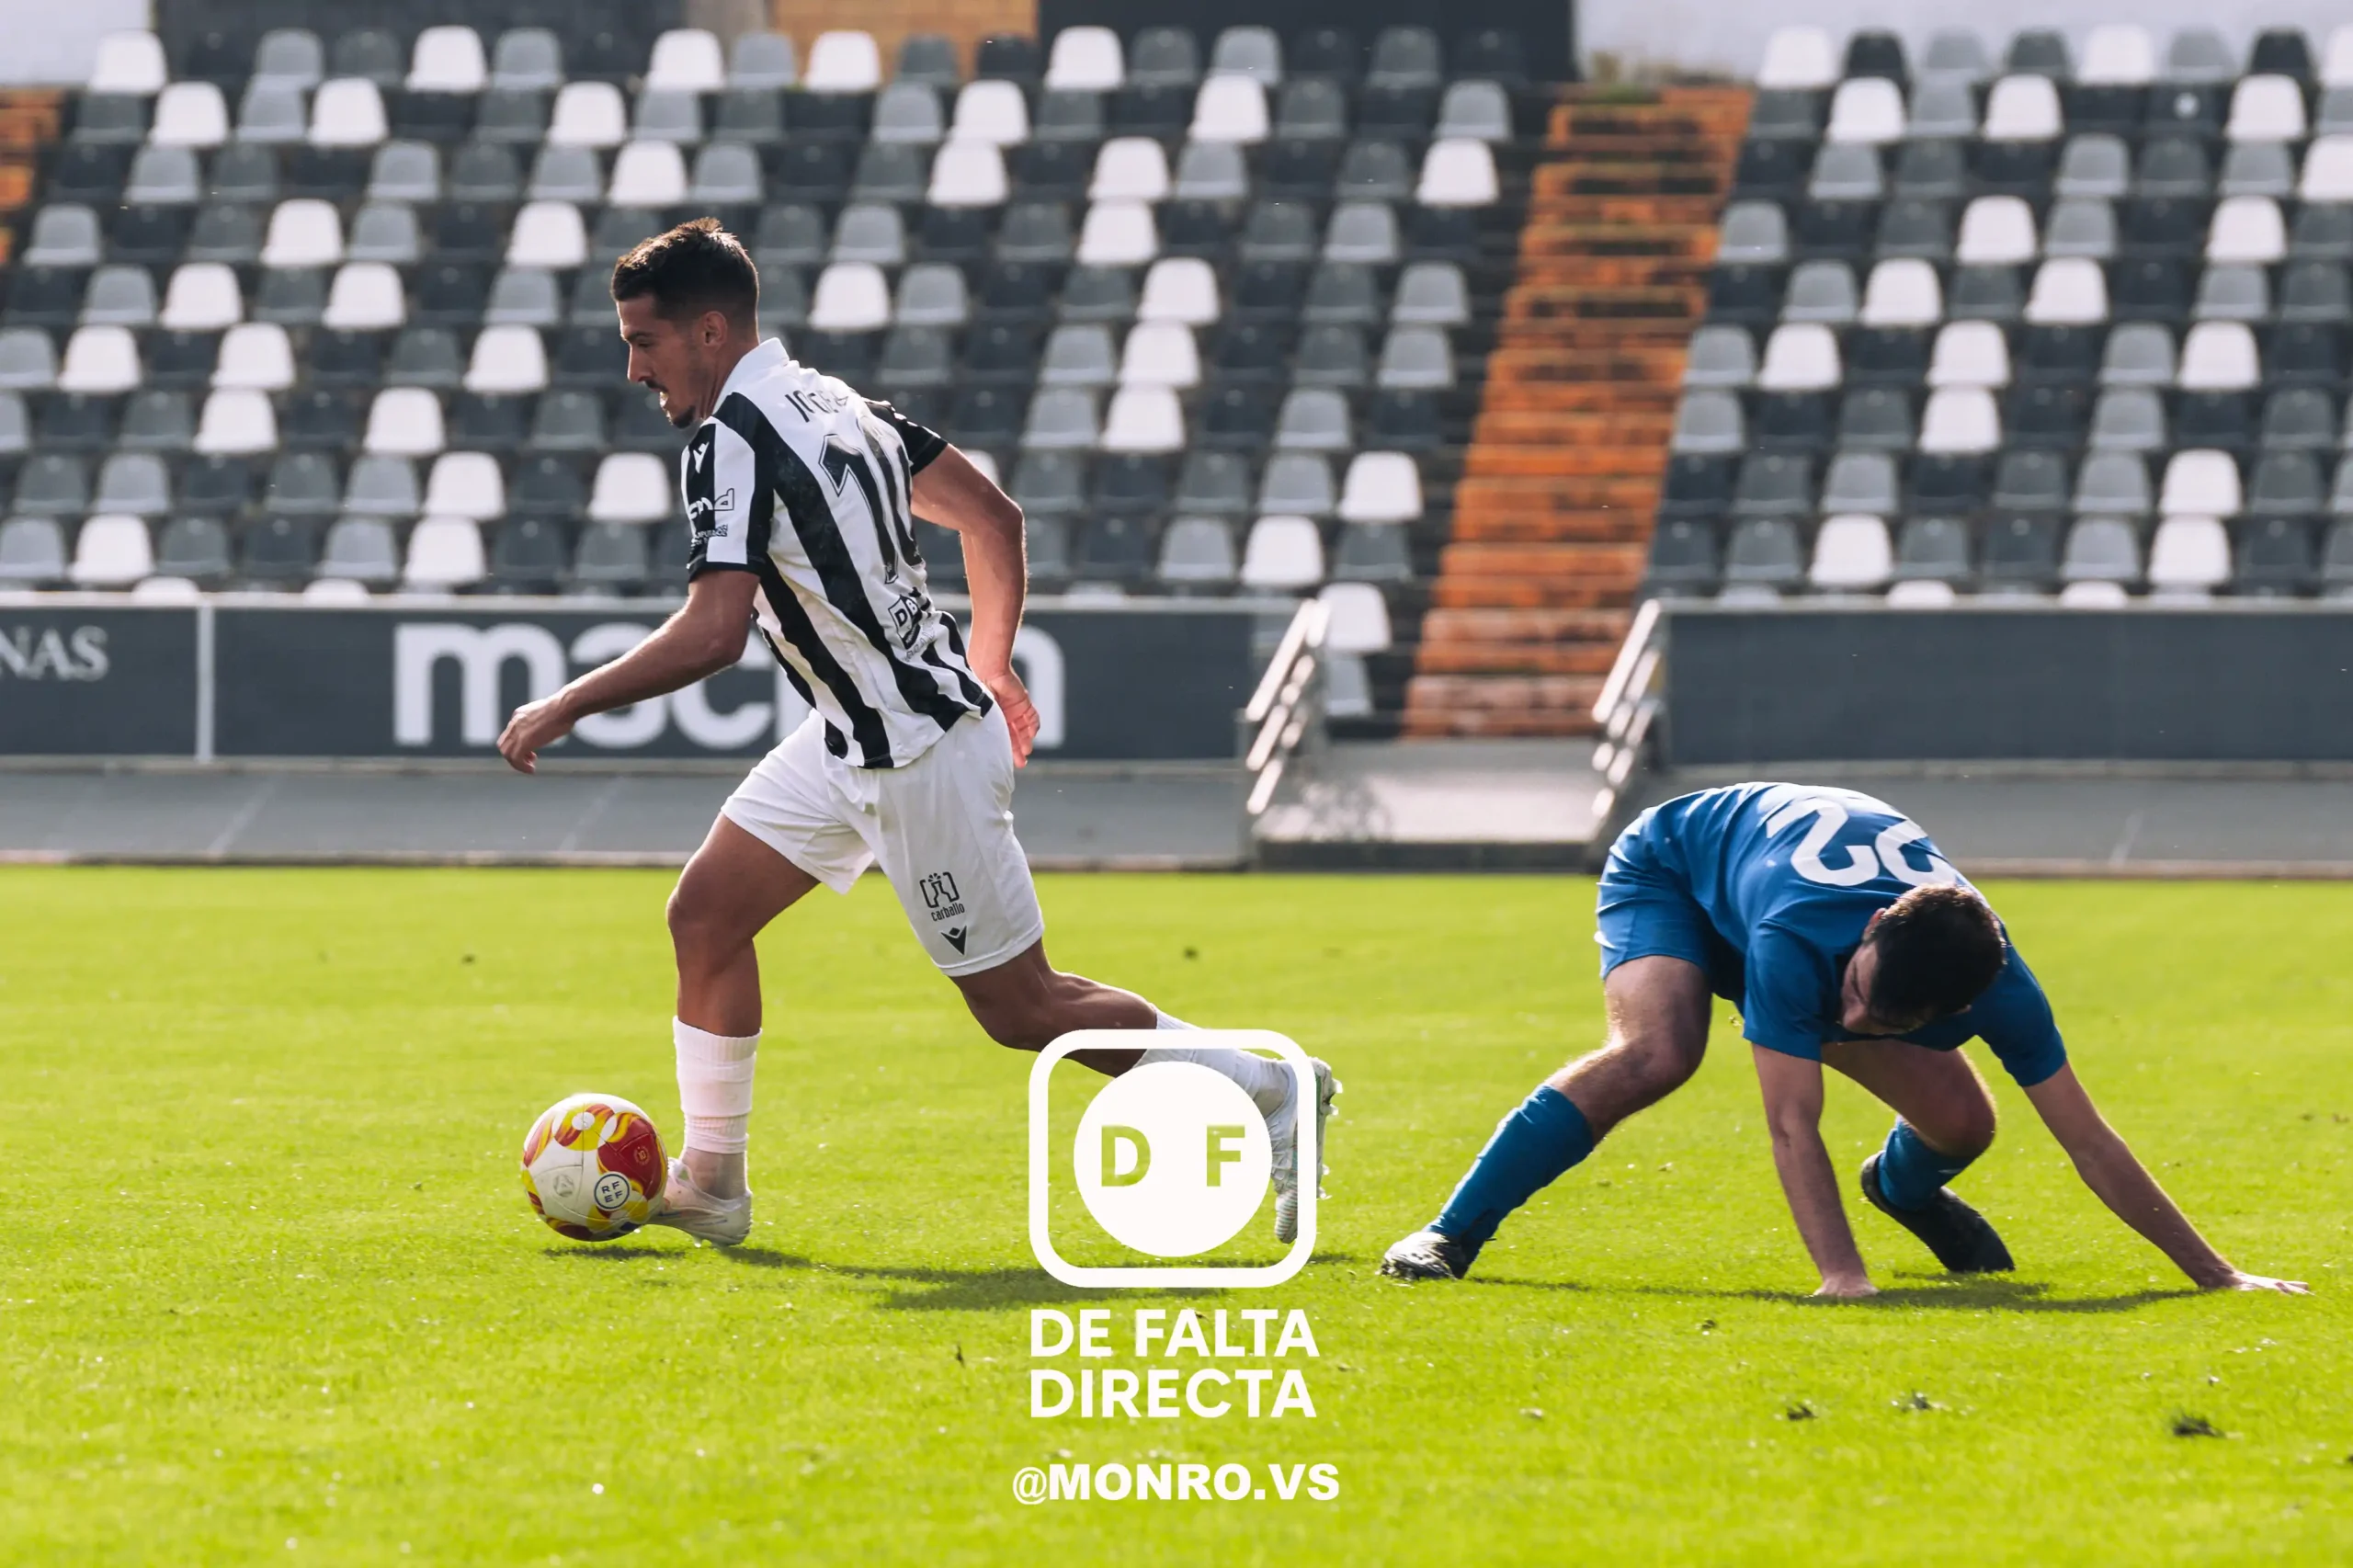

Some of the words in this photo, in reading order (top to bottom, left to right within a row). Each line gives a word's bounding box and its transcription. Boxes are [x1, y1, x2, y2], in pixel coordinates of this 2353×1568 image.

[0, 624, 109, 682] NAS
[1766, 796, 1957, 888] 22
[931, 903, 965, 922] carballo
